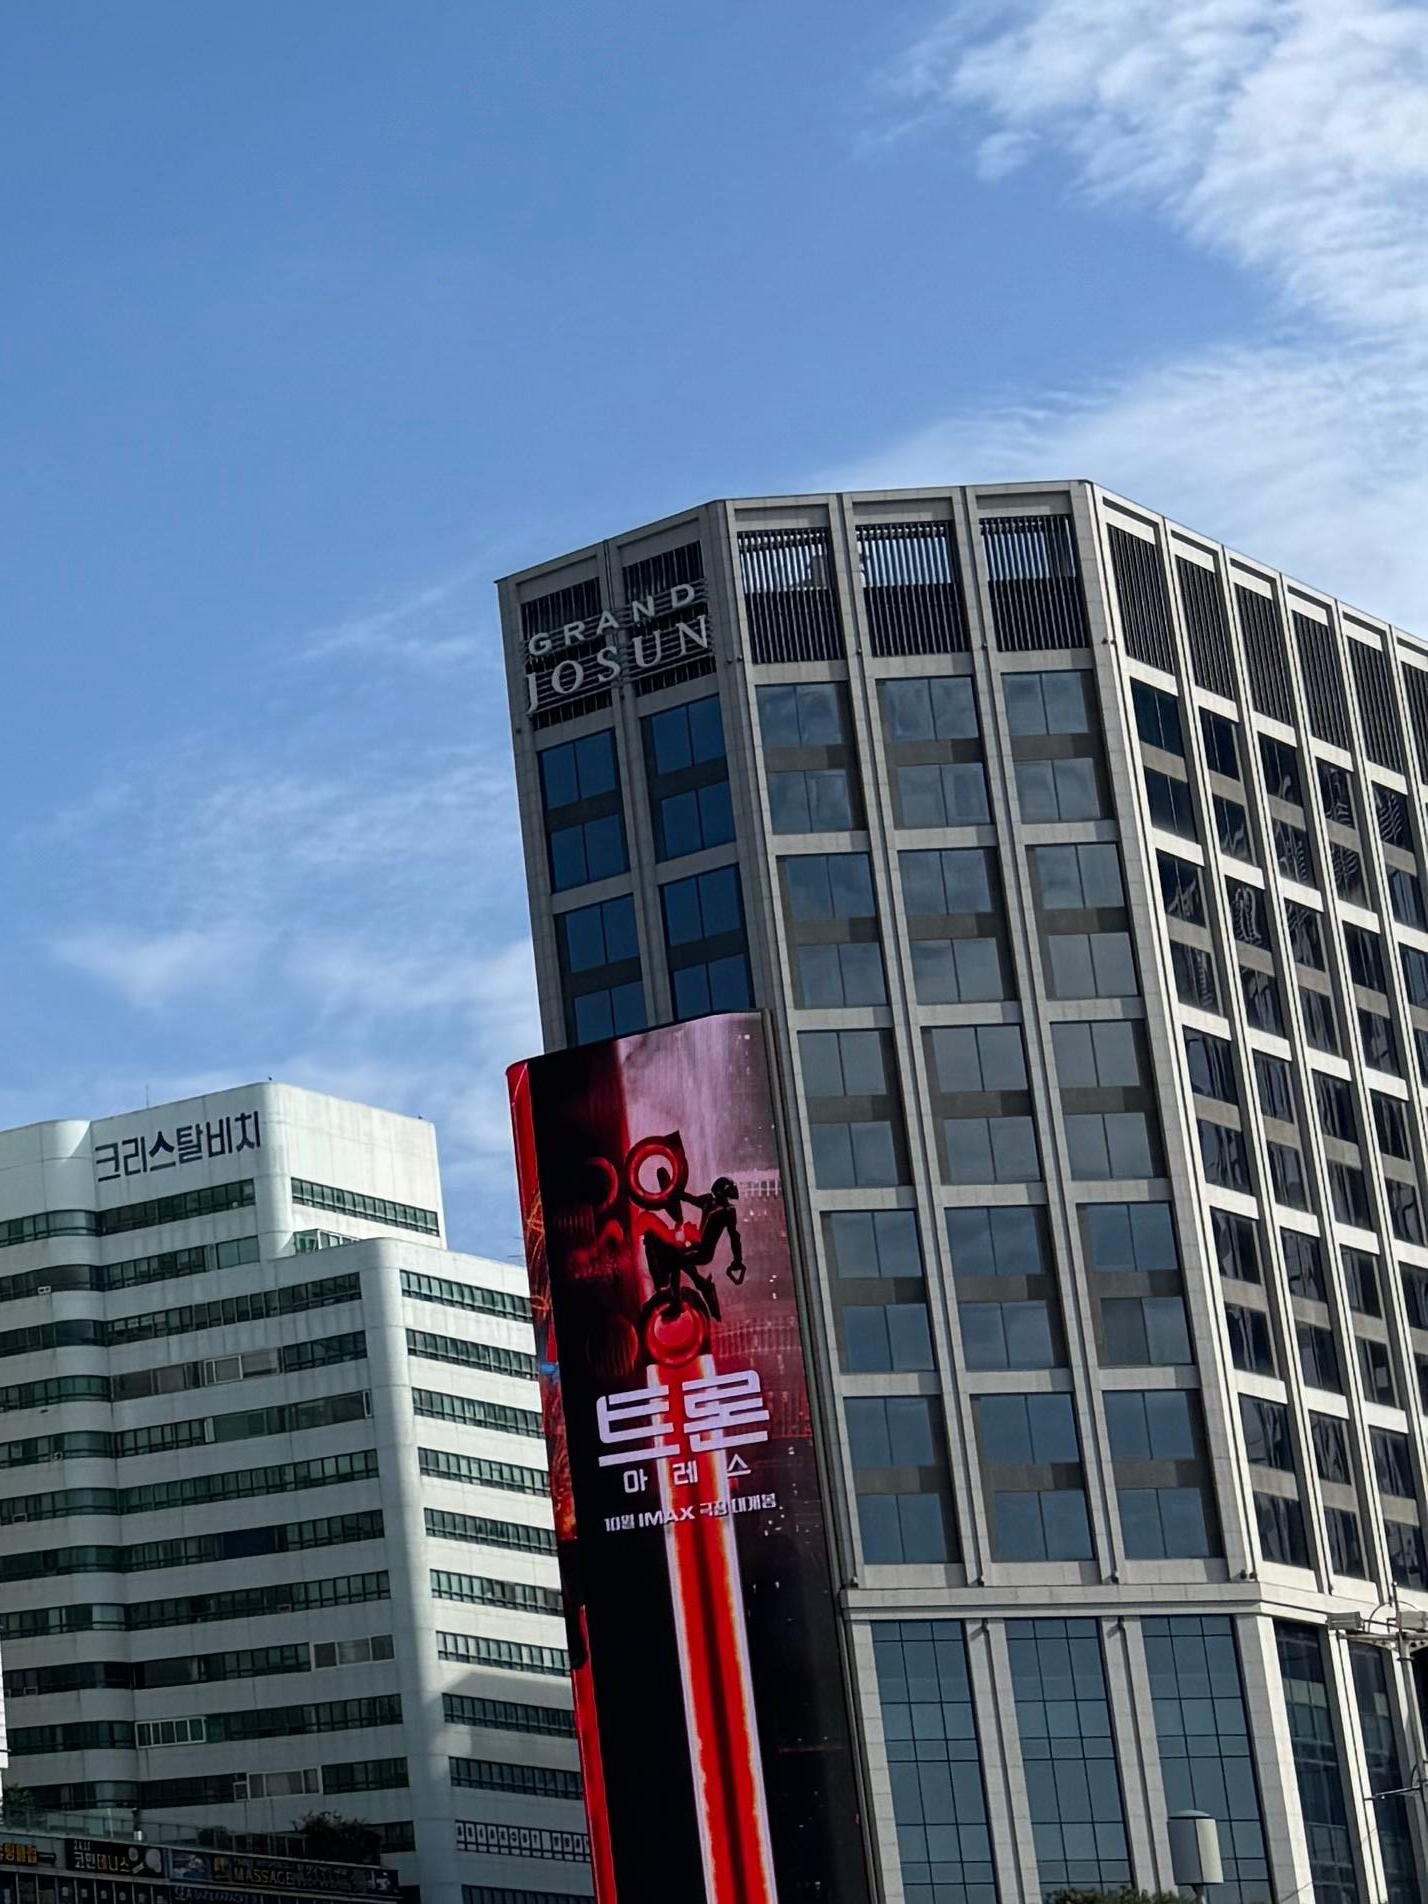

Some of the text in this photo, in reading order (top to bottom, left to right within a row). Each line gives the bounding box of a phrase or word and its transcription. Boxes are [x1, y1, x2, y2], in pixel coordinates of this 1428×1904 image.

[528, 583, 695, 657] GRAND
[526, 614, 709, 714] JOSUN
[94, 1110, 262, 1183] 크리스탈비치
[596, 1369, 770, 1467] 트론
[603, 1514, 635, 1532] 10월
[639, 1505, 695, 1527] IMAX
